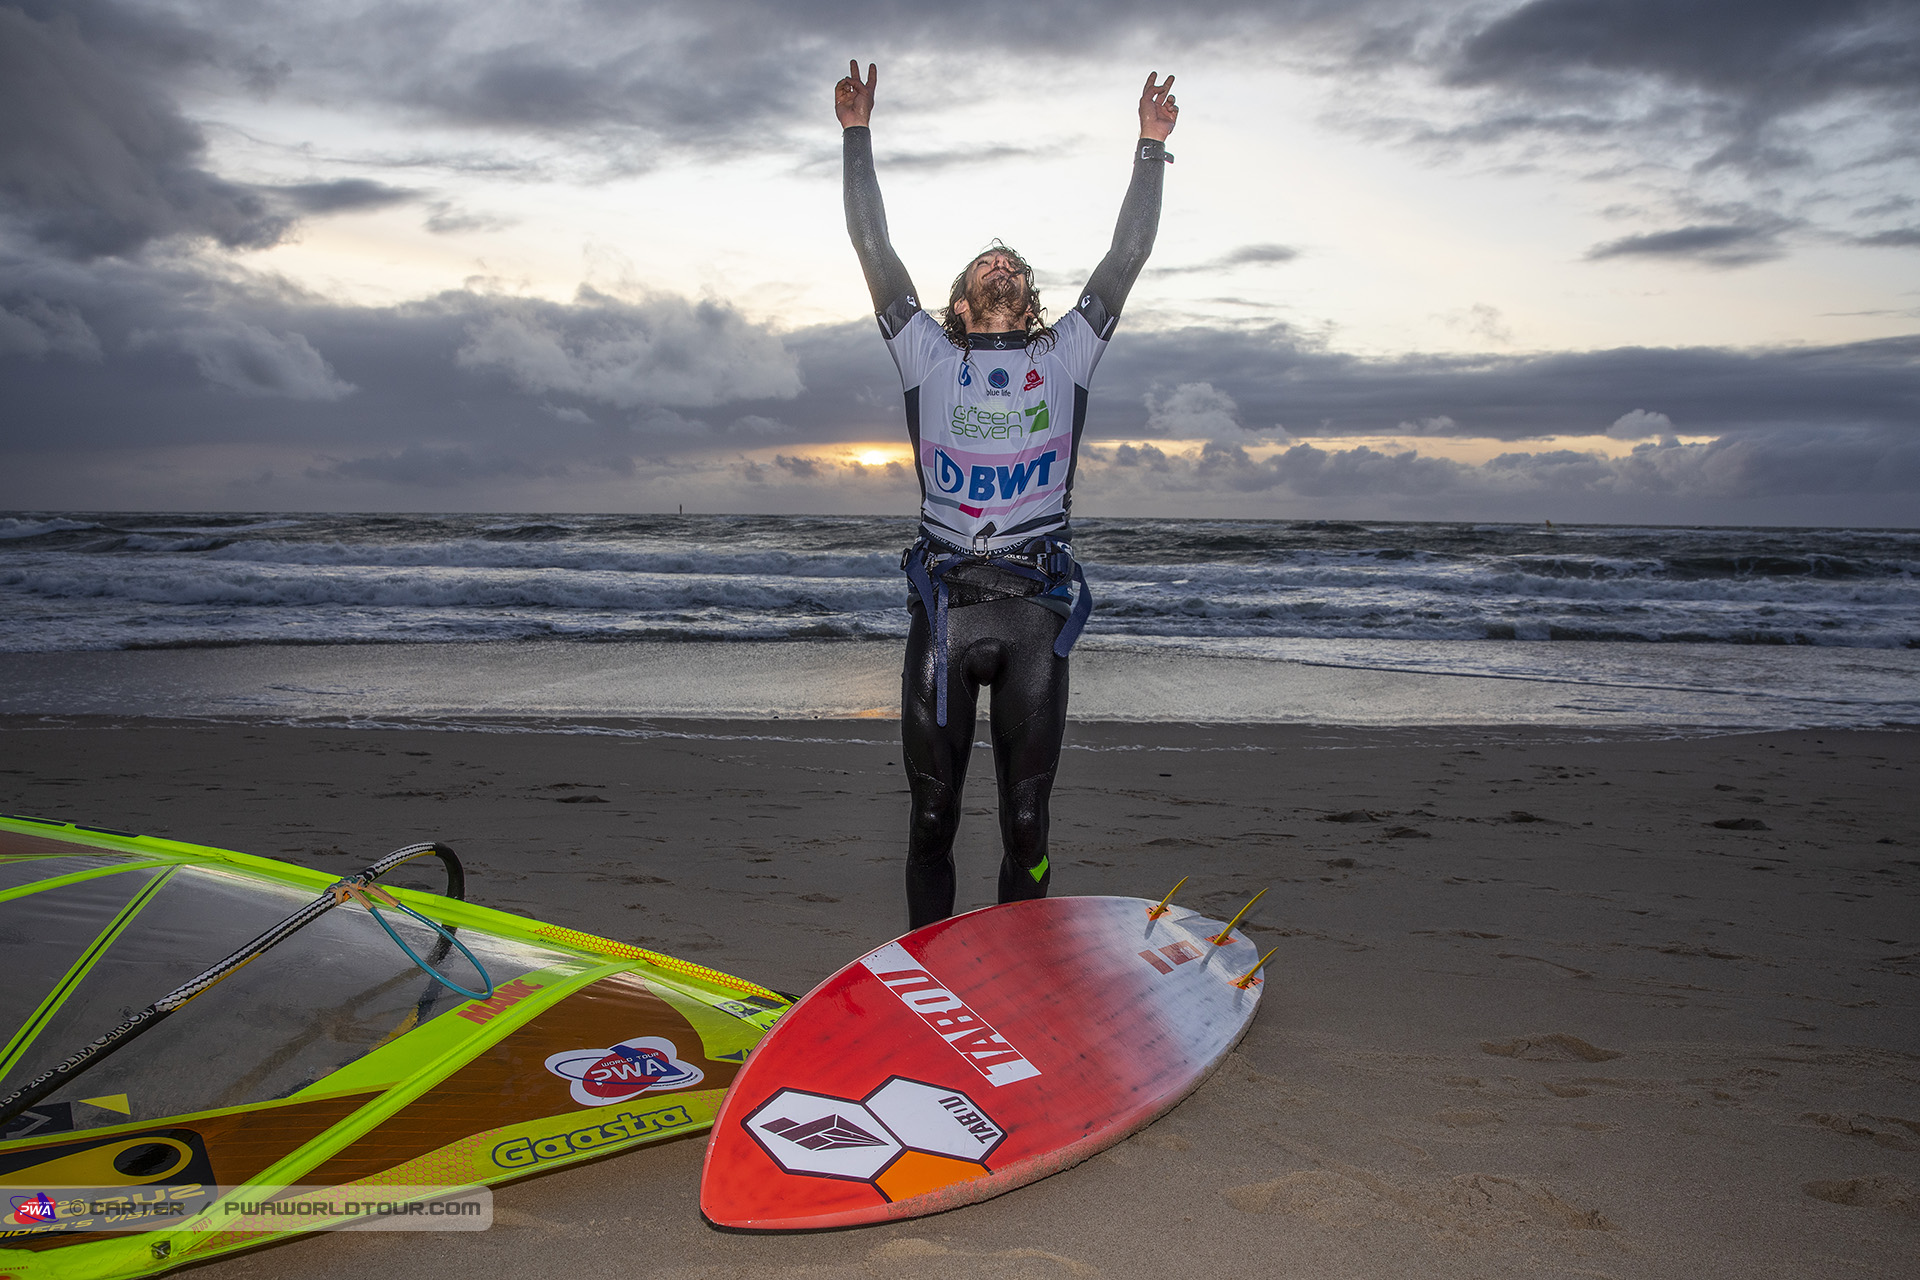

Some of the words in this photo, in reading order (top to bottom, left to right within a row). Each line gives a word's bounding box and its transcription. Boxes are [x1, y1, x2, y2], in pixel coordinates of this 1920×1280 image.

[968, 450, 1057, 501] BWT
[876, 968, 1025, 1077] TABOU
[28, 1070, 54, 1088] 200
[55, 1043, 97, 1073] SLIM
[590, 1058, 668, 1086] PWA
[601, 1057, 633, 1068] WORLD
[636, 1051, 660, 1060] TOUR
[492, 1104, 692, 1168] Gaastra
[938, 1096, 998, 1144] TABOU
